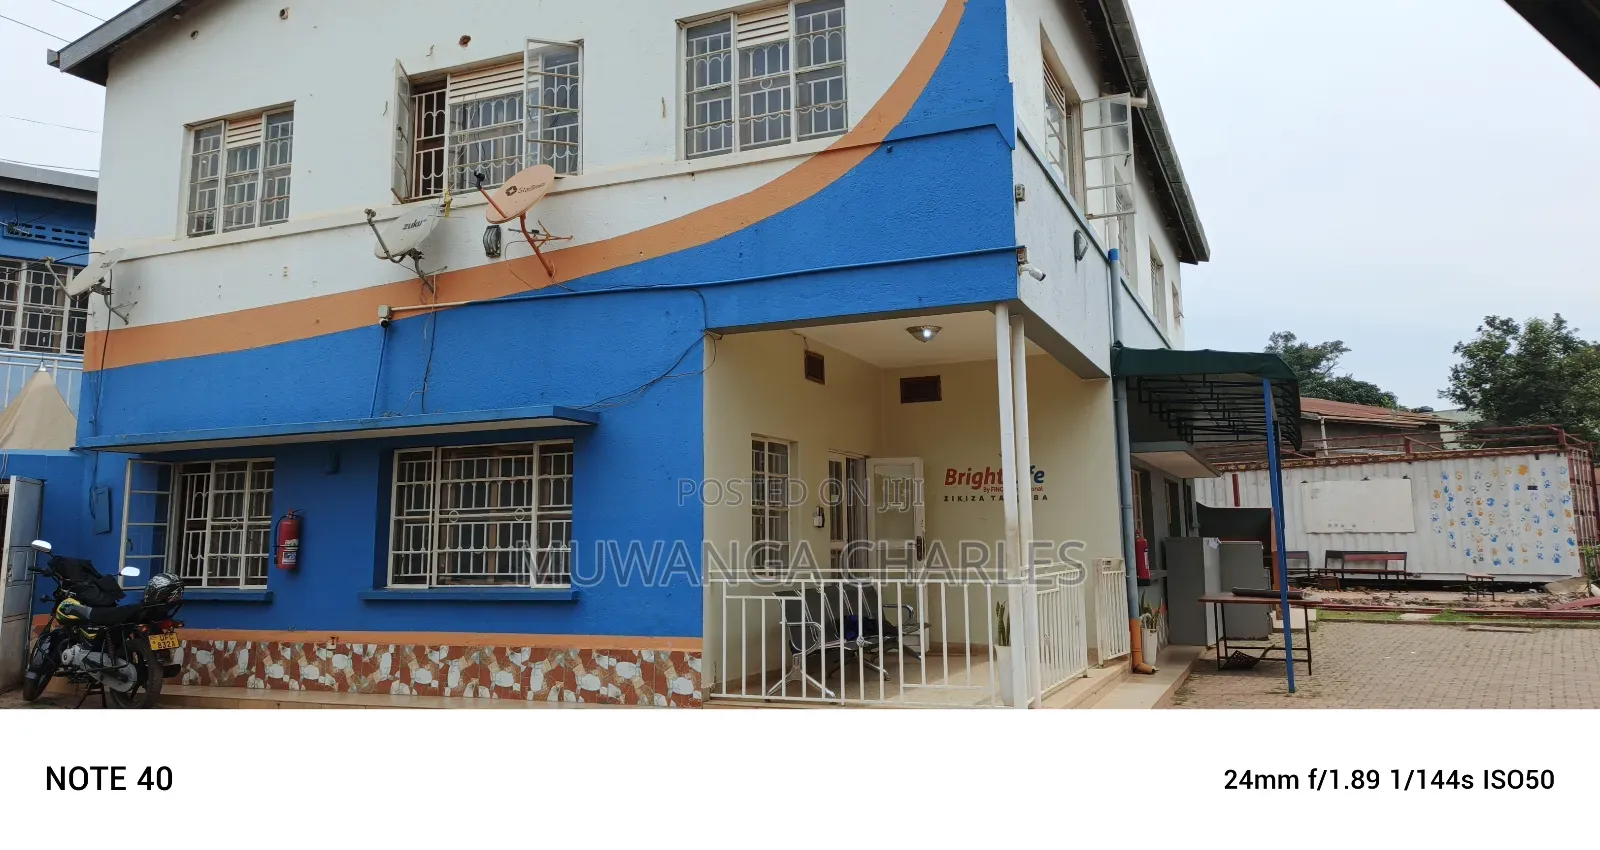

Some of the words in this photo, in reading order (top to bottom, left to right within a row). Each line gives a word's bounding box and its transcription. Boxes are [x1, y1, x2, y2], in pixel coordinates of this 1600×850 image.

[402, 218, 424, 231] zuku
[944, 464, 1045, 490] Brighte
[991, 494, 1048, 502] TABA
